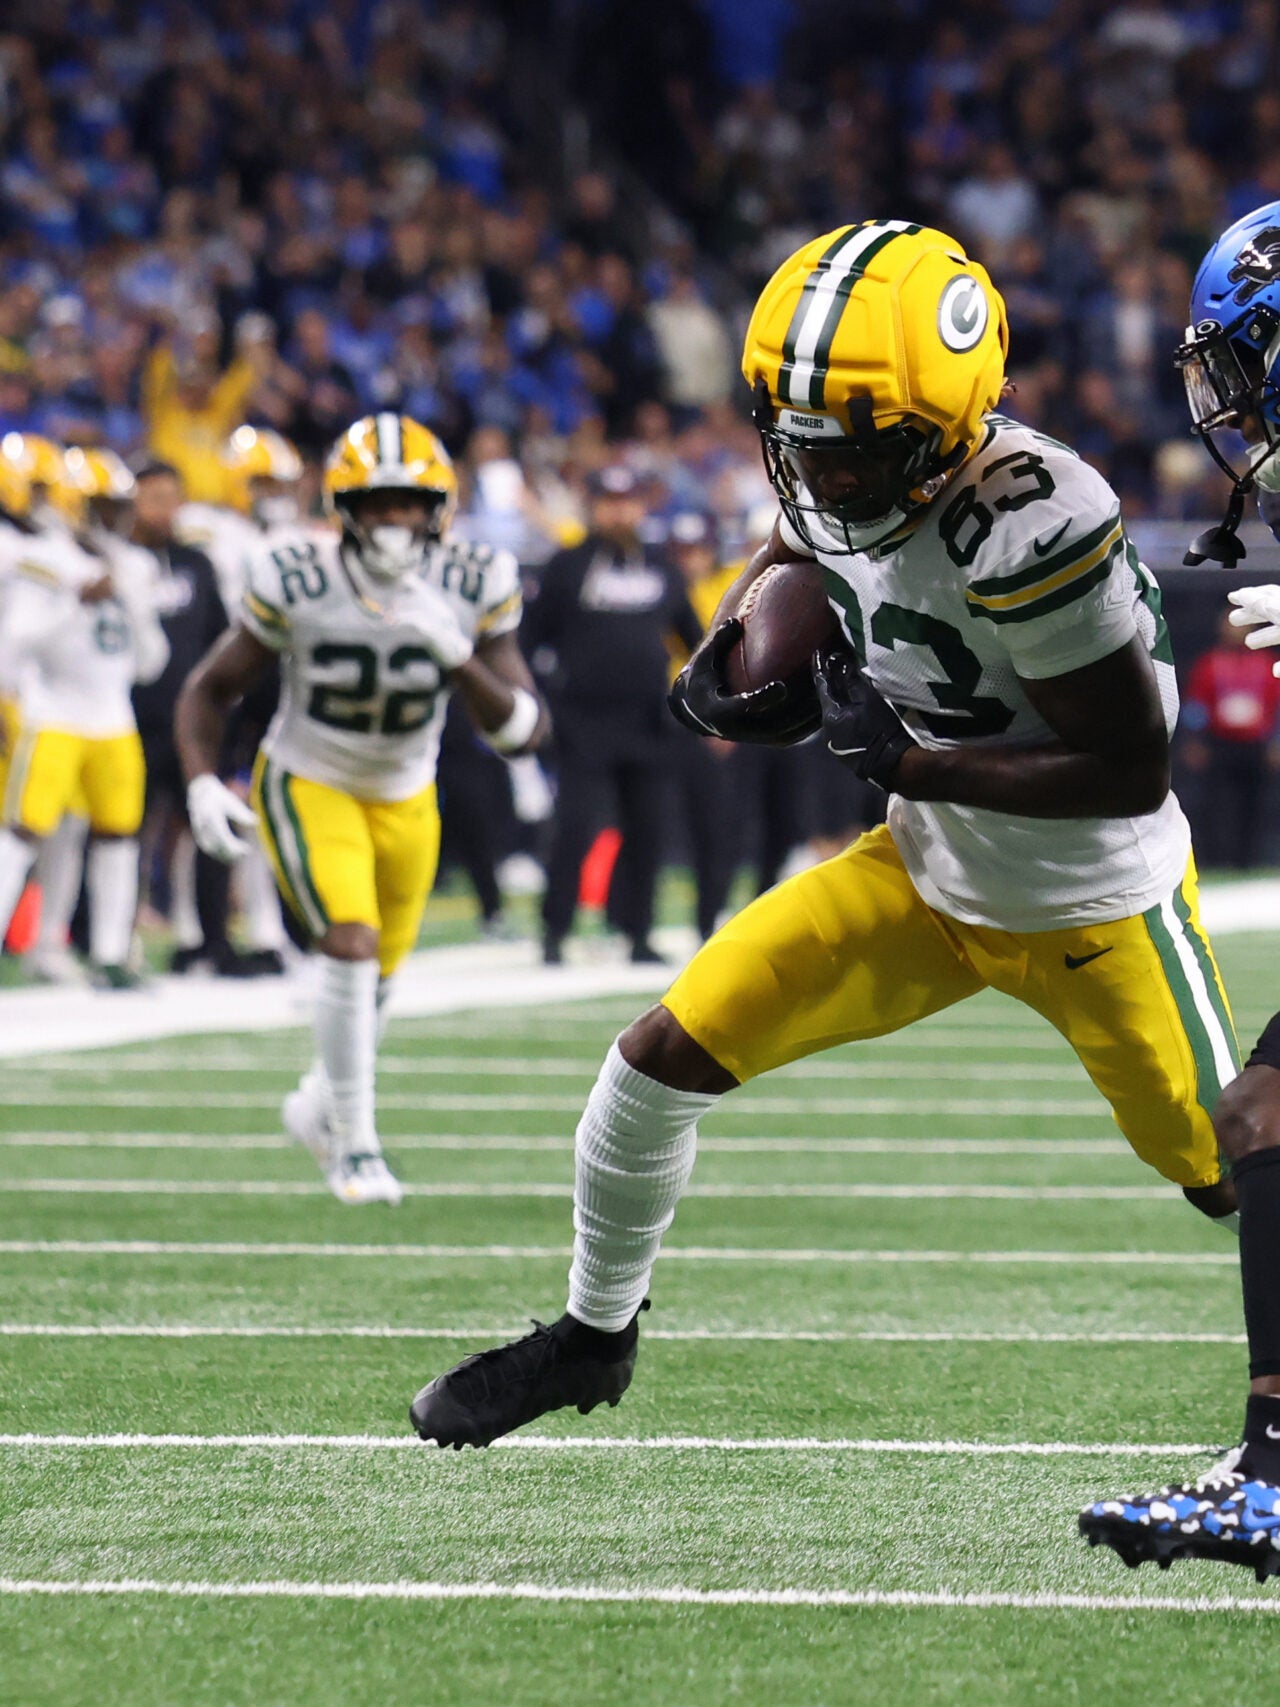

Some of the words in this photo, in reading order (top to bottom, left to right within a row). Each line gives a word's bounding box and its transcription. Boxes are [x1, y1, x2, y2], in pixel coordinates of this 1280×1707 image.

[790, 414, 825, 430] PACKERS
[938, 450, 1056, 568] 83
[272, 543, 328, 604] 22
[308, 643, 451, 734] 22
